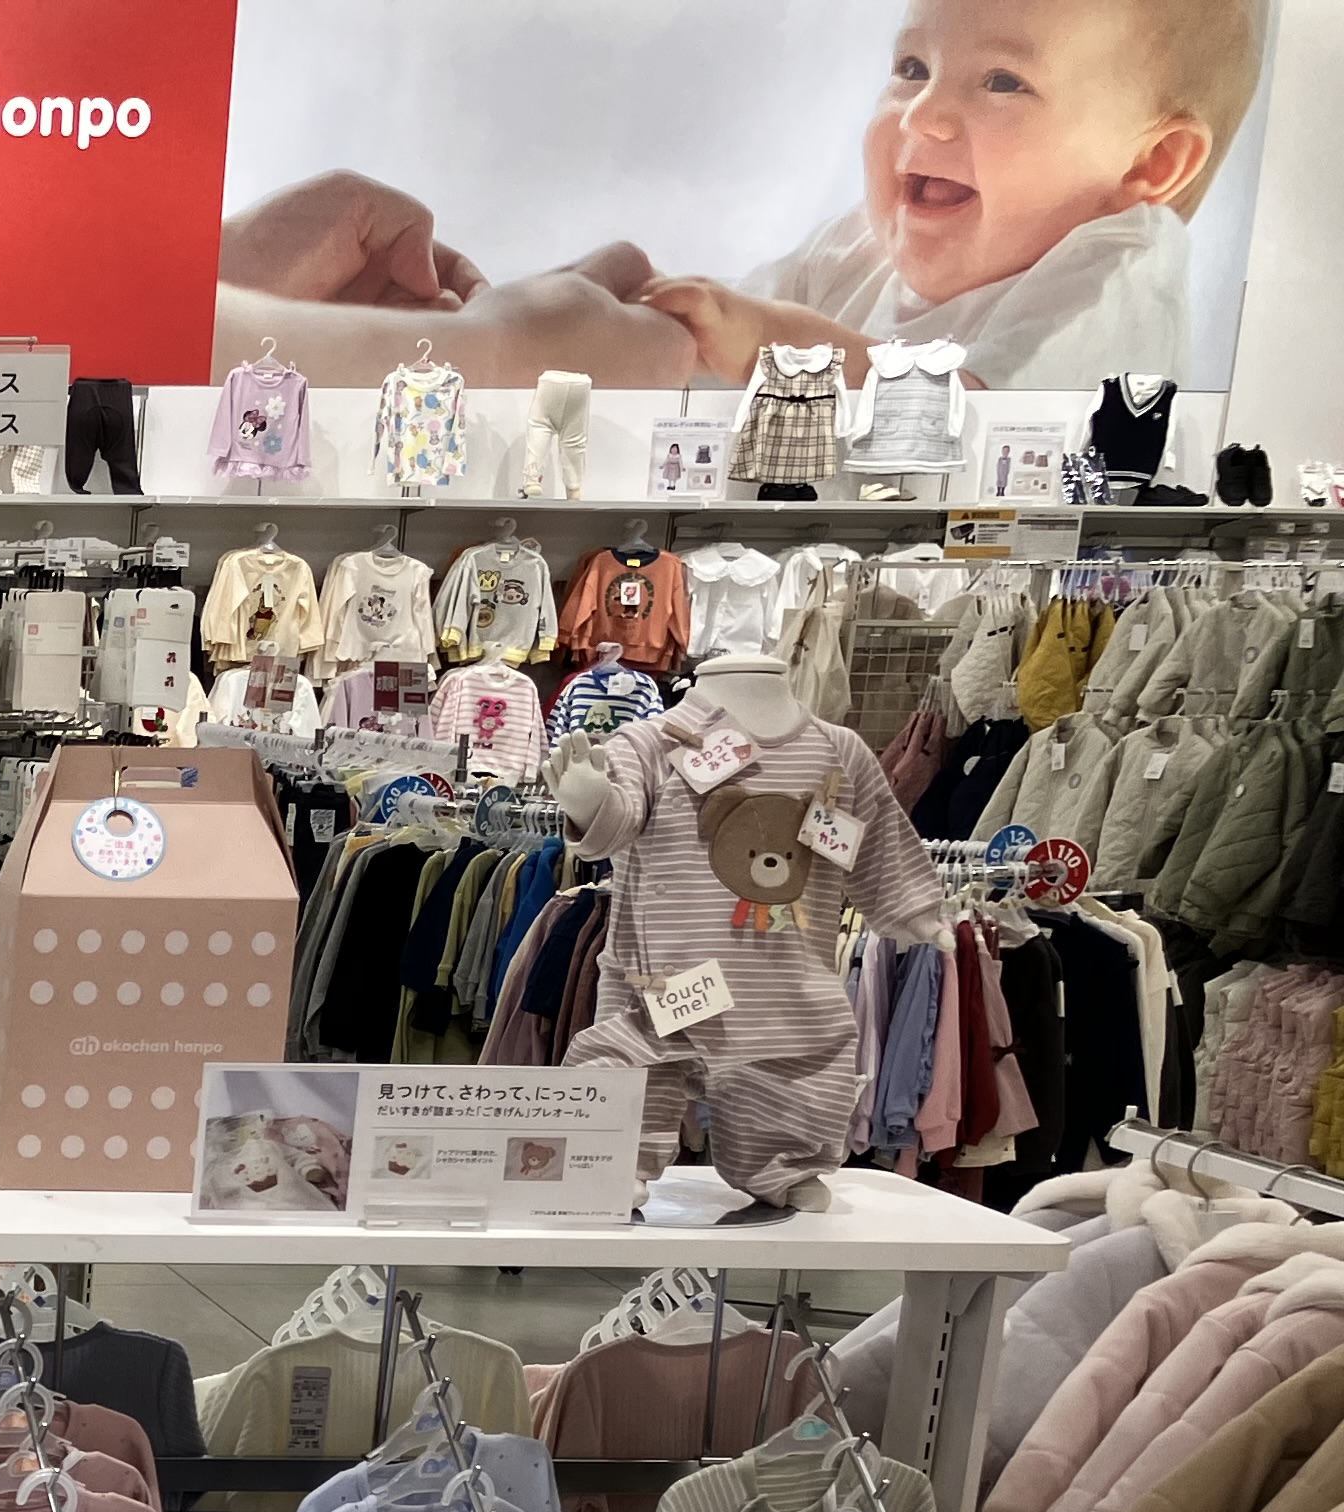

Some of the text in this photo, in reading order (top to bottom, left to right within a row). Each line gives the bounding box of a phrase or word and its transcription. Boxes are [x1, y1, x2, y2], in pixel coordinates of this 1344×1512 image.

[690, 735, 733, 768] さわって
[707, 753, 731, 771] みて
[656, 975, 716, 1009] touch
[672, 992, 711, 1020] me!
[378, 1083, 607, 1103] 見つけて、さわって、にっこり。
